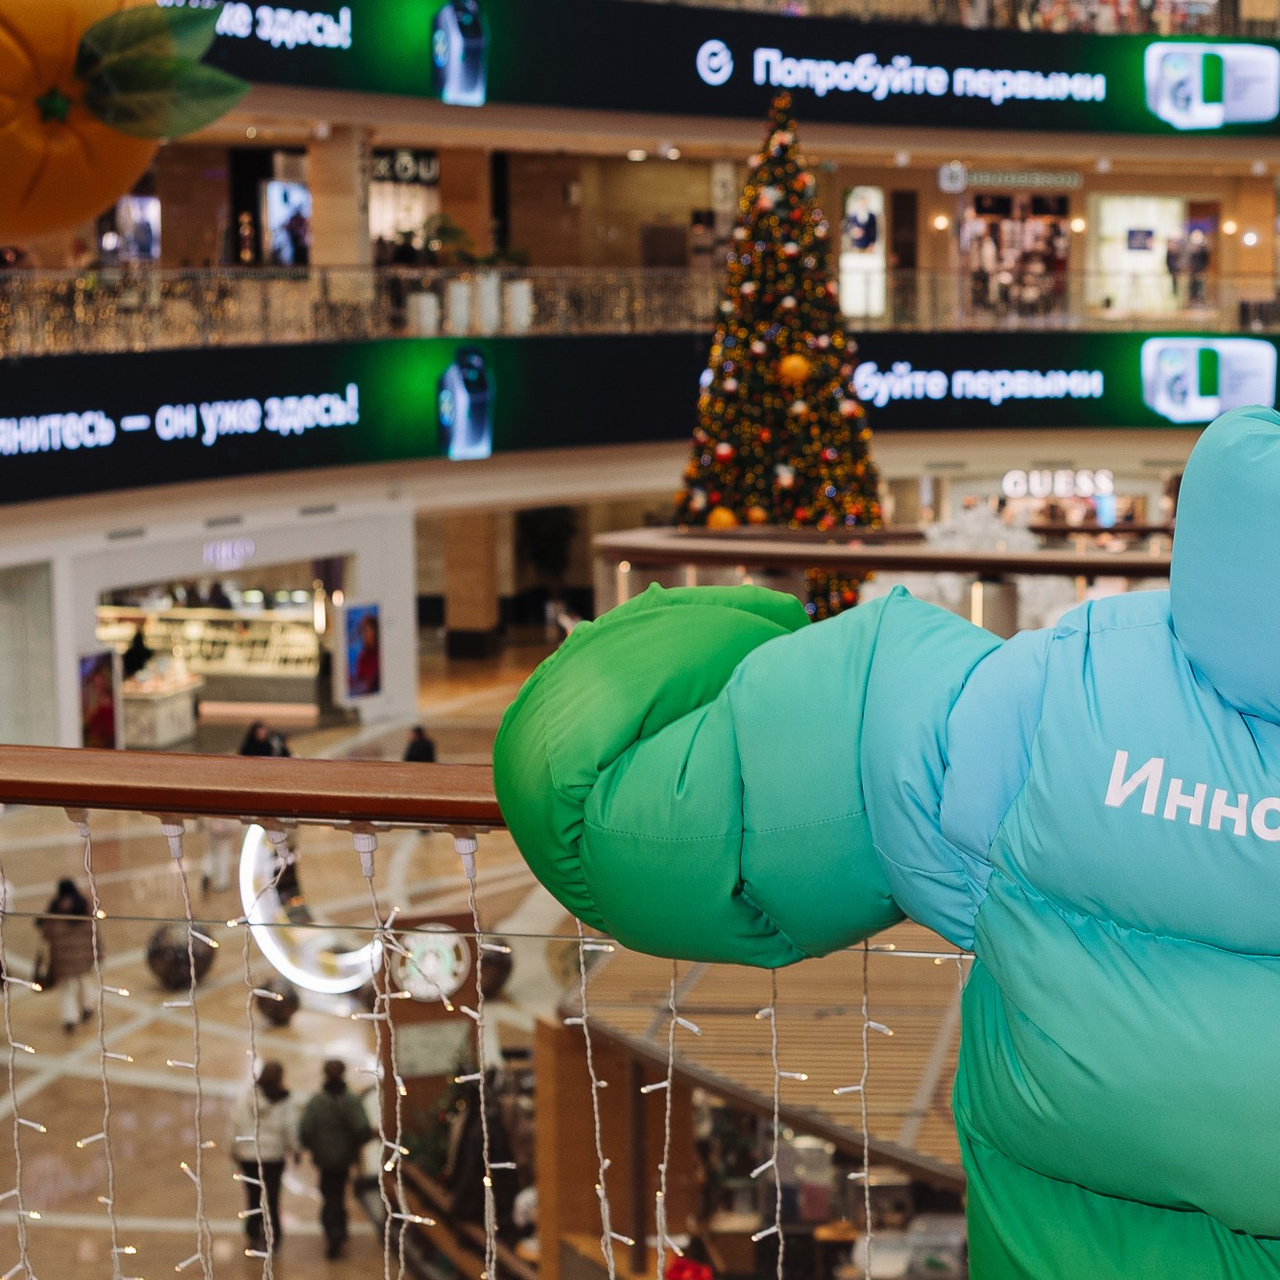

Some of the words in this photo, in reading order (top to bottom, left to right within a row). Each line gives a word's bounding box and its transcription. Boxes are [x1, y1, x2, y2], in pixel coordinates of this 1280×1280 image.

[255, 6, 352, 50] здесь!
[753, 47, 949, 102] Попробуйте
[952, 67, 1107, 106] первыми
[951, 369, 1104, 406] первыми
[155, 403, 197, 440] он
[199, 397, 262, 446] уже
[264, 382, 359, 435] здесь!
[1001, 468, 1114, 499] GUESS
